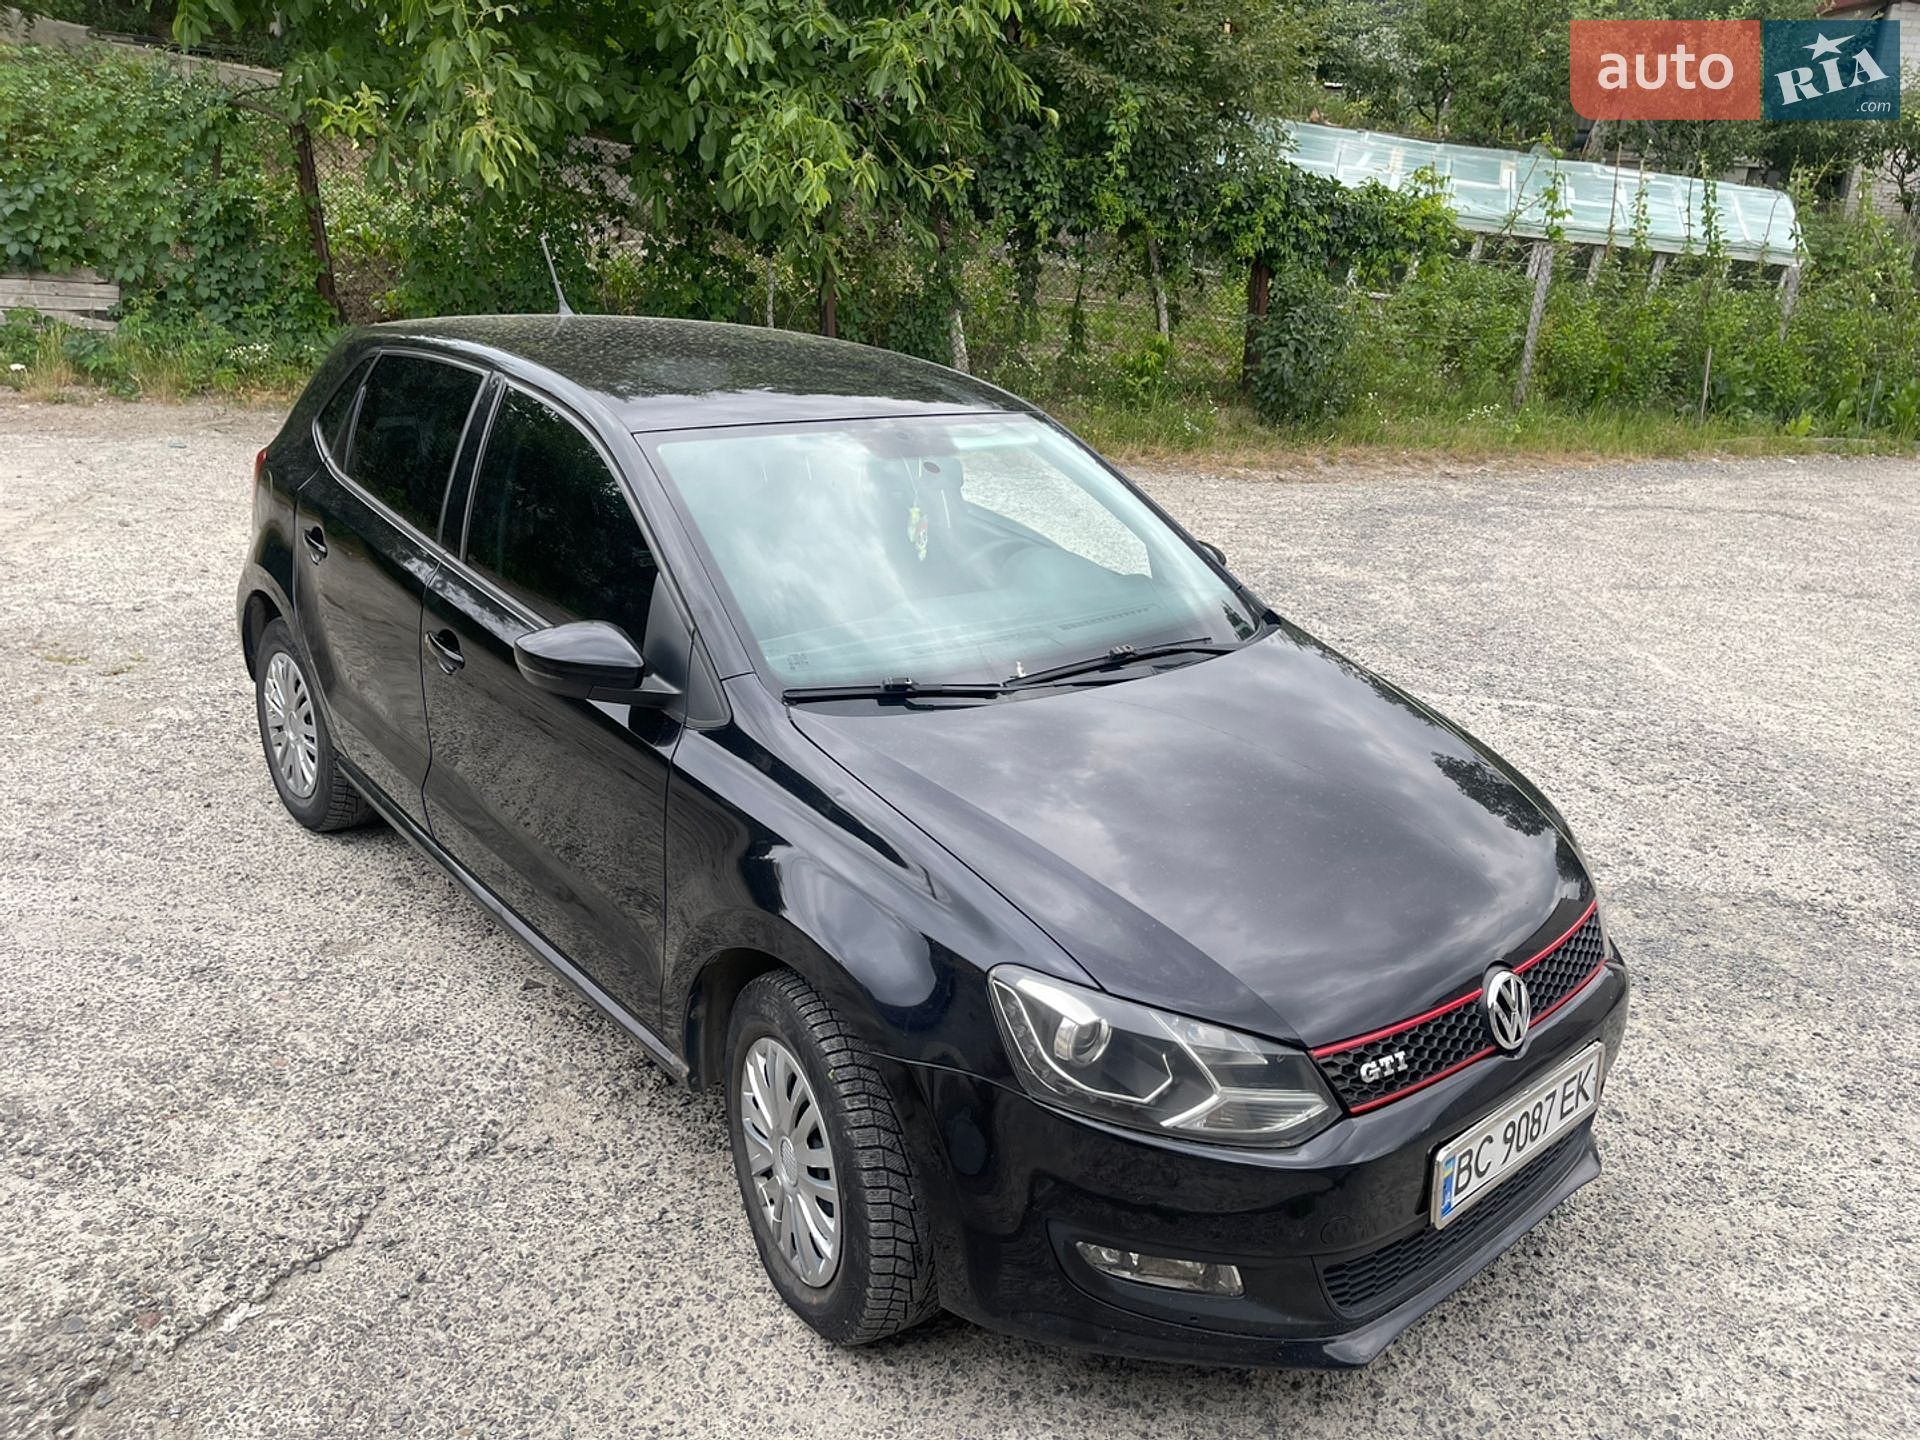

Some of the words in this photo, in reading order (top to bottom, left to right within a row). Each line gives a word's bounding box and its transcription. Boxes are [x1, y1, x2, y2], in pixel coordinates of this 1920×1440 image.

[1360, 1051, 1408, 1083] GTI
[1454, 1135, 1493, 1197] BC
[1501, 1089, 1557, 1166] 9087
[1560, 1062, 1594, 1120] EK
